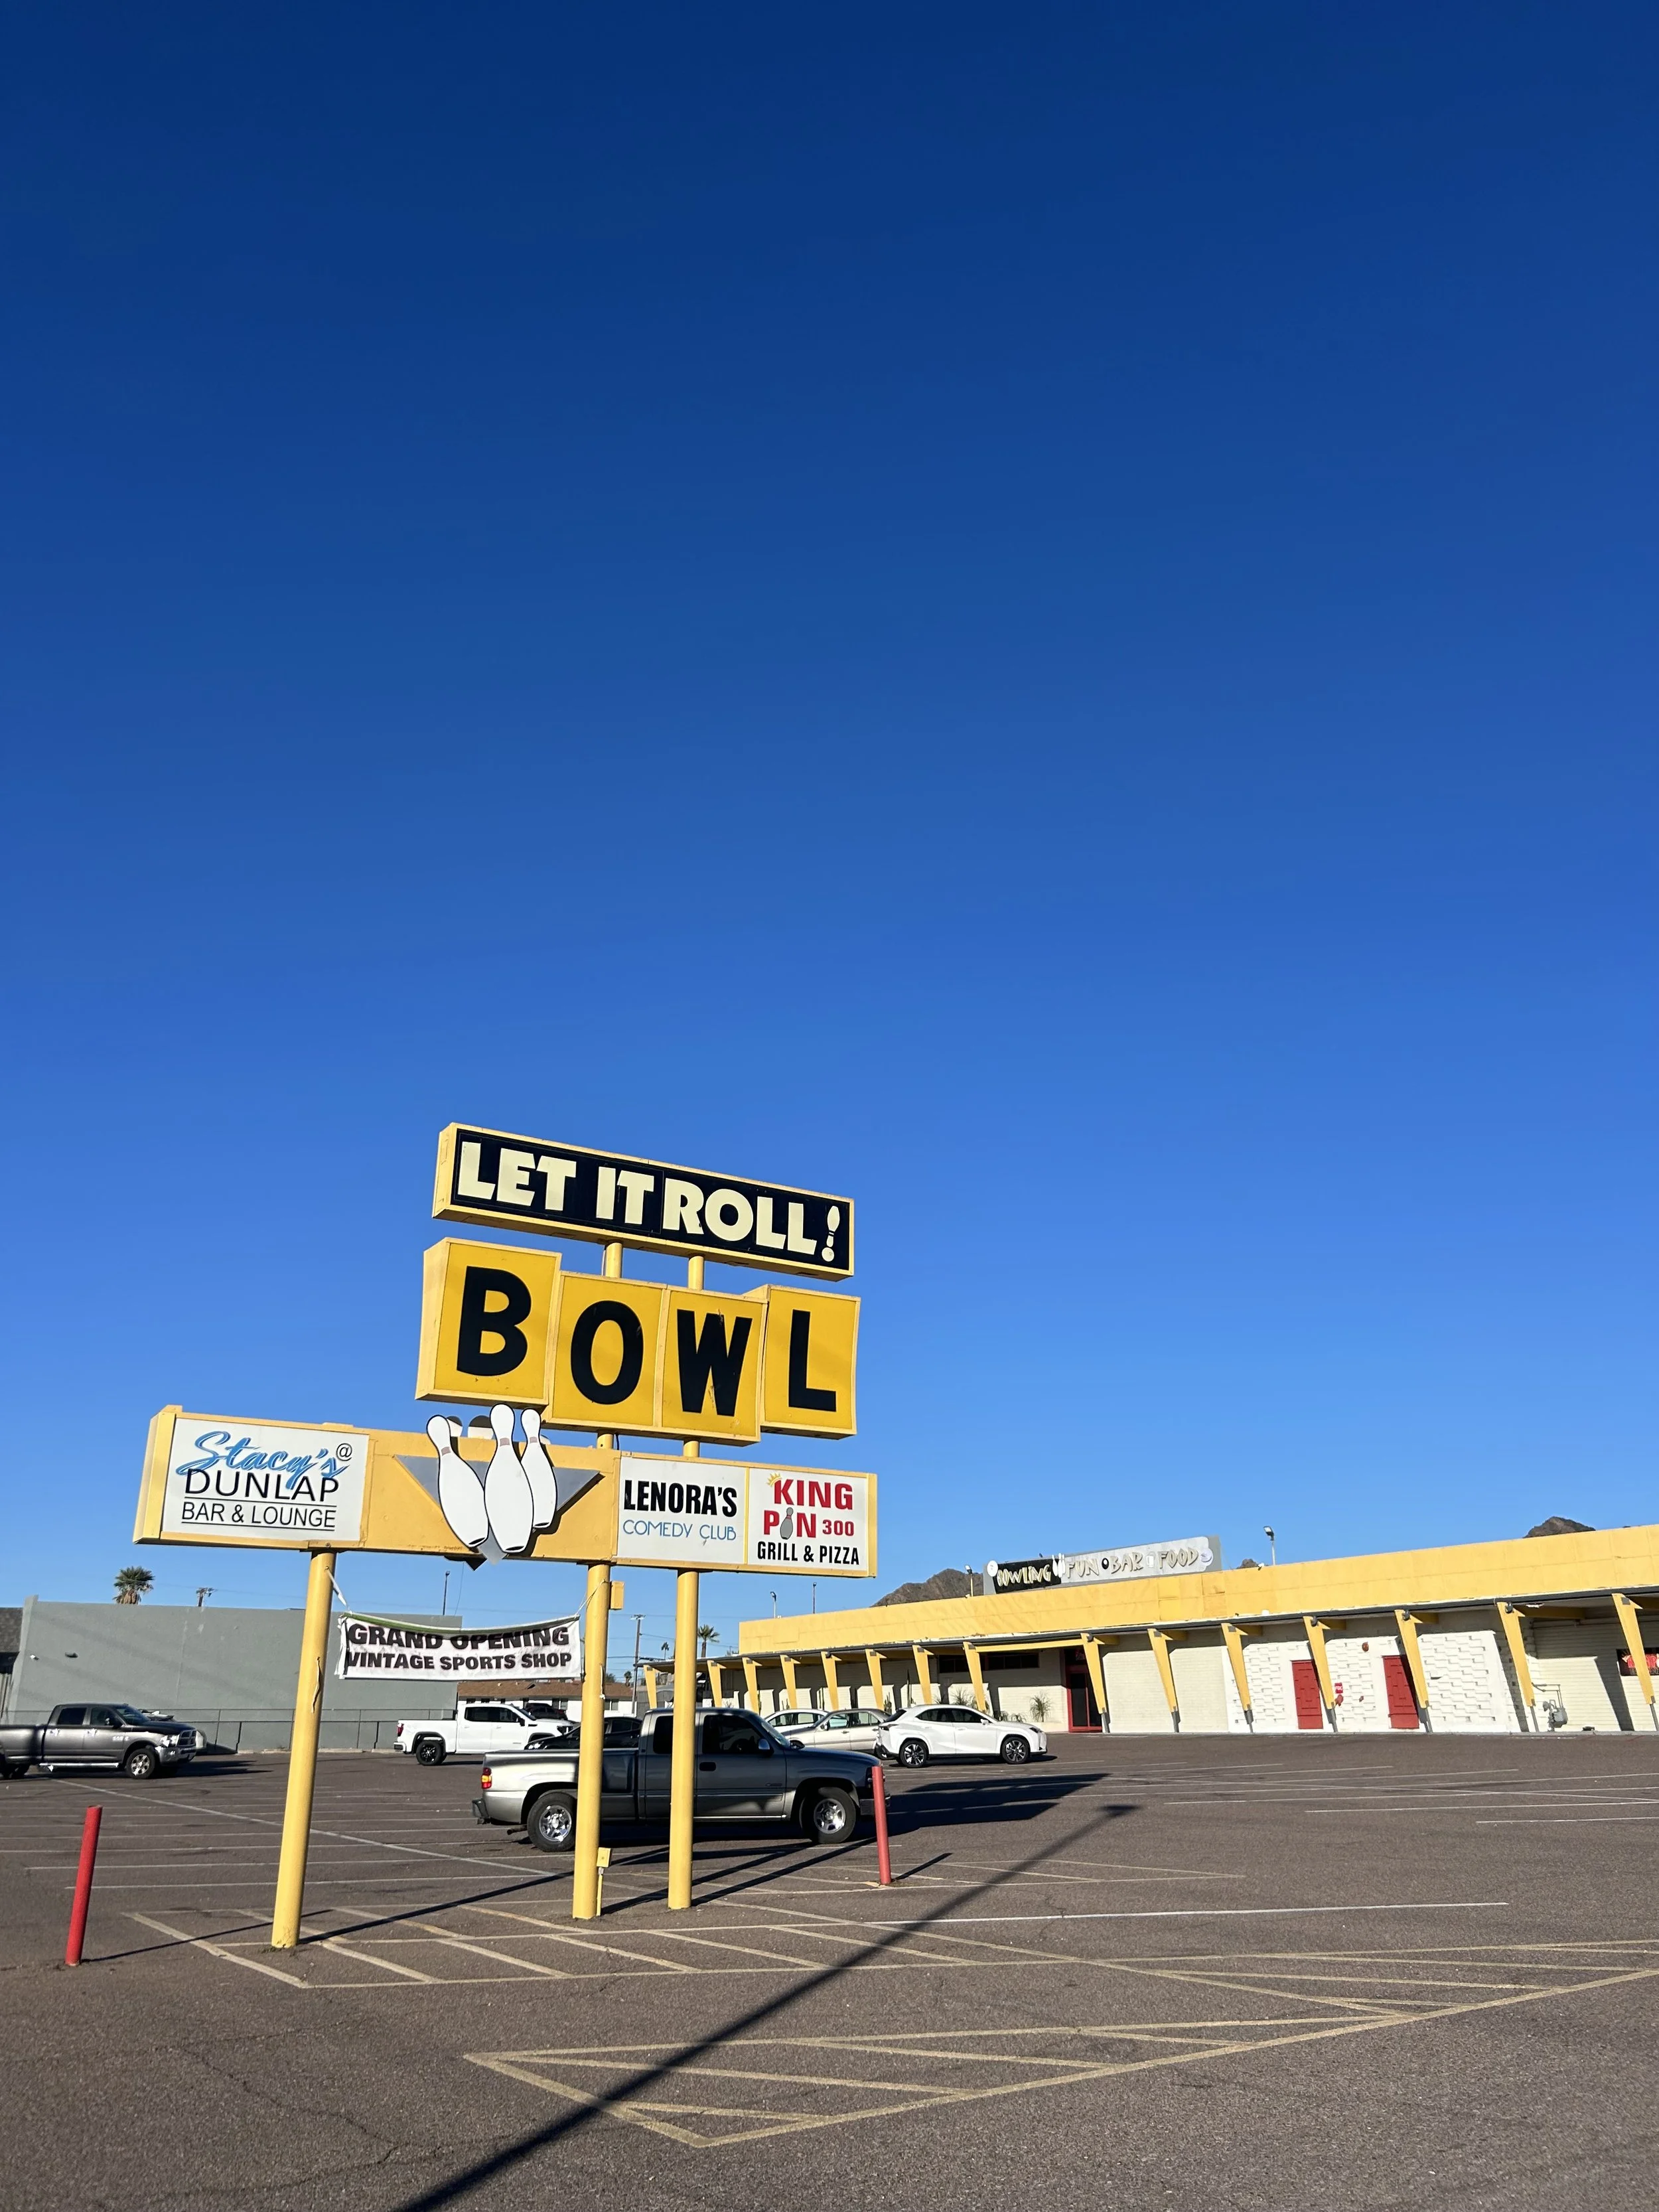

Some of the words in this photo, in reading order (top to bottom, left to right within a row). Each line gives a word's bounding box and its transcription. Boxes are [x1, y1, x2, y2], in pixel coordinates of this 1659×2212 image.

[457, 1142, 577, 1211] LET
[597, 1166, 654, 1224] IT
[662, 1178, 841, 1262] ROLL!
[457, 1266, 837, 1416] BOWL
[176, 1431, 350, 1490] Stacy's
[184, 1468, 340, 1503] DUNLAP
[624, 1479, 737, 1518] LENORA'S
[773, 1479, 853, 1511] KING
[182, 1501, 224, 1522] BAR
[231, 1505, 245, 1524] &
[252, 1505, 336, 1528] LOUNGE
[622, 1519, 693, 1538] COMEDY
[699, 1524, 737, 1541] CLUB
[763, 1507, 817, 1540] PIN
[822, 1518, 854, 1537] 300
[757, 1541, 798, 1562] GRILL
[803, 1544, 814, 1563] &
[820, 1545, 860, 1566] PIZZA
[997, 1564, 1052, 1587] BOWLING
[1066, 1558, 1100, 1579] FUN
[1111, 1551, 1144, 1574] BAR
[1157, 1546, 1199, 1569] FOOD
[348, 1623, 444, 1649] GRAND
[450, 1627, 569, 1650] OPENING
[348, 1652, 435, 1670] VINTAGE
[440, 1655, 516, 1670] SPORTS
[521, 1653, 572, 1668] SHOP
